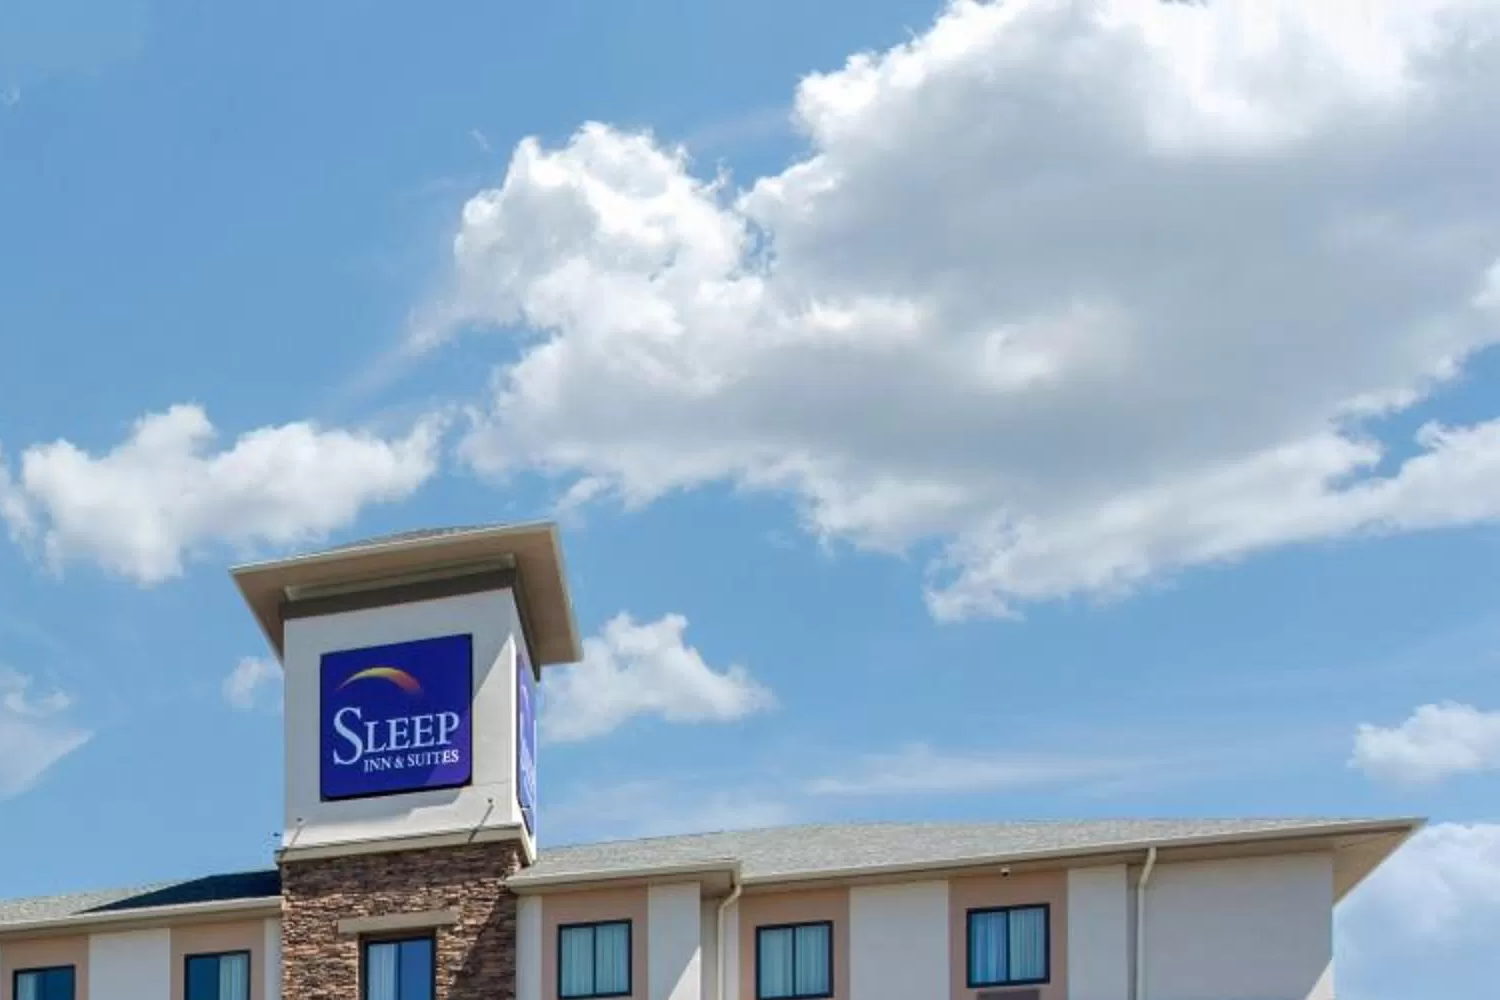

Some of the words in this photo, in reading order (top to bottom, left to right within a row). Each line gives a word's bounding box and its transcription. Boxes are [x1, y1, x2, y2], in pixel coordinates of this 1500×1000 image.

[333, 706, 460, 765] SLEEP
[363, 757, 392, 773] INN
[394, 756, 405, 769] &
[407, 749, 460, 766] SUITES
